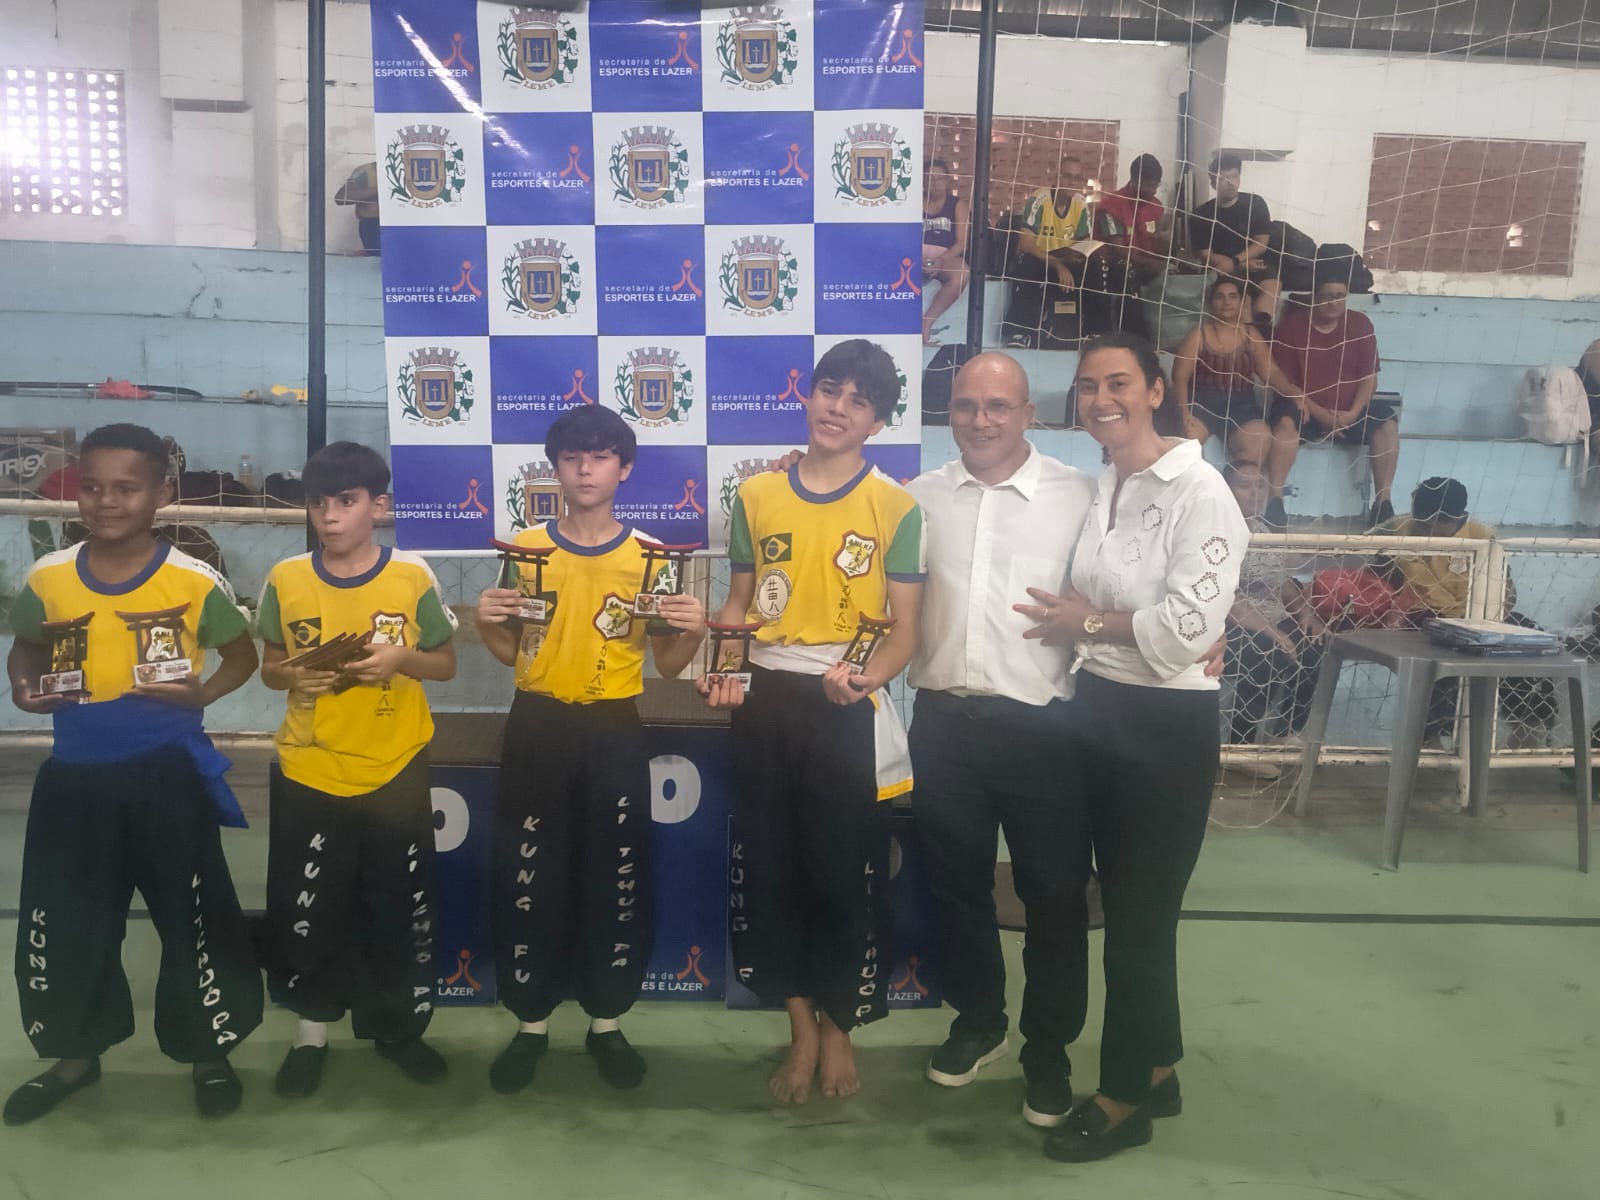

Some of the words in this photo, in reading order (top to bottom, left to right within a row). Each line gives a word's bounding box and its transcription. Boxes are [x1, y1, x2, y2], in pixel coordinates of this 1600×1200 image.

[374, 59, 425, 67] secretaria
[599, 58, 650, 66] secretaria
[654, 57, 666, 66] de
[823, 56, 874, 64] secretaria
[374, 68, 426, 78] ESPORTES
[599, 67, 650, 76] ESPORTES
[652, 67, 659, 76] E
[661, 67, 693, 76] LAZER
[822, 65, 874, 75] ESPORTES
[876, 65, 883, 74] E
[885, 65, 917, 74] LAZER
[765, 168, 777, 176] de
[491, 179, 541, 188] ESPORTES
[552, 179, 584, 188] LAZER
[710, 177, 761, 187] ESPORTES
[763, 177, 770, 186] E
[772, 177, 803, 187] LAZER
[438, 285, 450, 293] de
[605, 284, 655, 292] secretaria
[658, 284, 670, 292] de
[823, 282, 873, 290] secretaria
[385, 294, 435, 303] ESPORTES
[437, 294, 444, 302] E
[446, 294, 477, 302] LAZER
[605, 293, 655, 302] ESPORTES
[657, 293, 664, 302] E
[666, 293, 697, 302] LAZER
[823, 291, 874, 300] ESPORTES
[876, 291, 883, 300] E
[884, 291, 915, 300] LAZER
[496, 402, 546, 411] ESPORTES
[548, 402, 555, 411] E
[557, 402, 587, 411] LAZ
[711, 402, 761, 411] ESPORTES
[763, 402, 770, 411] E
[772, 402, 803, 411] LAZER
[395, 502, 442, 510] secretaria
[446, 501, 458, 509] de
[395, 510, 443, 519] ESPORTES
[445, 510, 451, 519] E
[453, 510, 483, 519] LAZER
[660, 511, 667, 520] E
[668, 511, 699, 520] LAZER
[514, 815, 542, 912] KUNG
[292, 832, 326, 937] KUNG
[730, 842, 749, 932] KUNG
[28, 906, 49, 992] KUNG
[513, 944, 531, 984] FU
[658, 981, 665, 991] E
[668, 982, 704, 992] LAZER
[437, 986, 475, 997] LAZER
[886, 991, 921, 1001] LAZER
